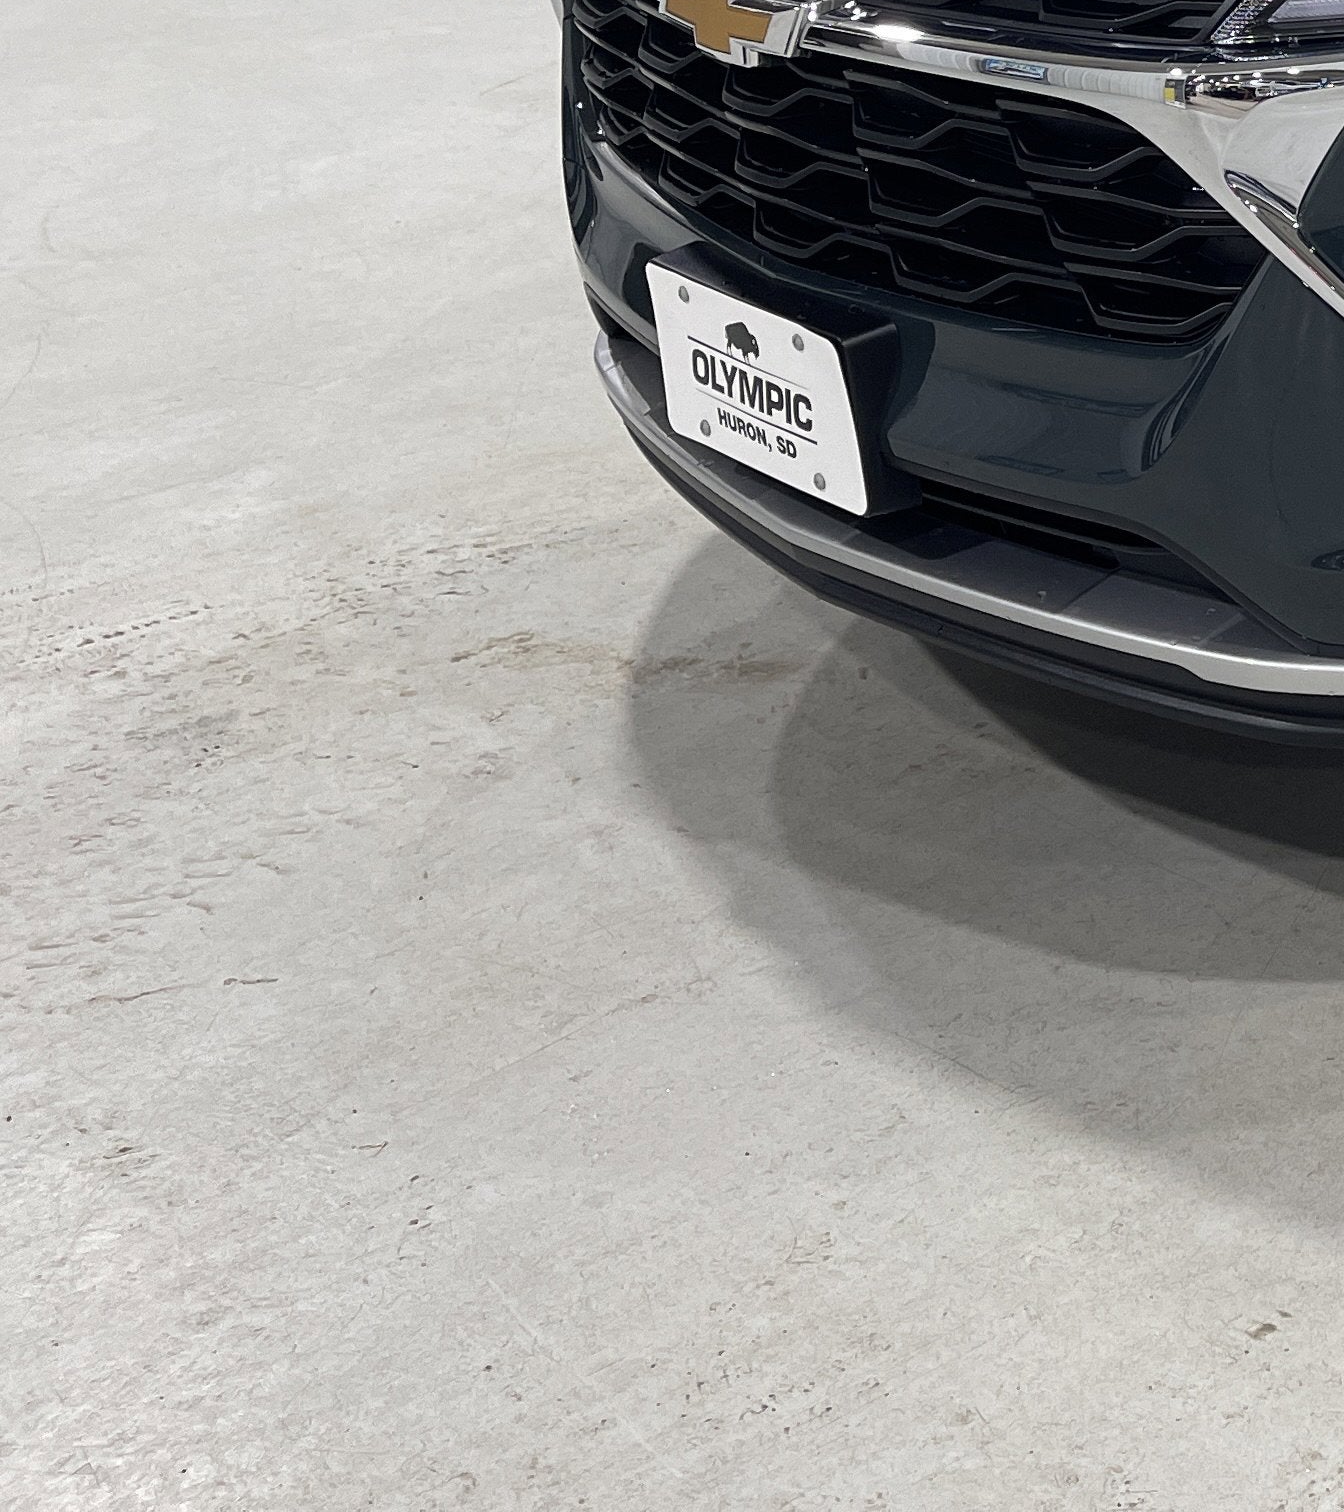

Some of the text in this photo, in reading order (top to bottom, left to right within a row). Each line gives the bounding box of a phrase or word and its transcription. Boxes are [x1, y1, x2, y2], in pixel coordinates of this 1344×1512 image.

[692, 348, 813, 432] OLYMPIC
[716, 407, 797, 459] HURON, SD
